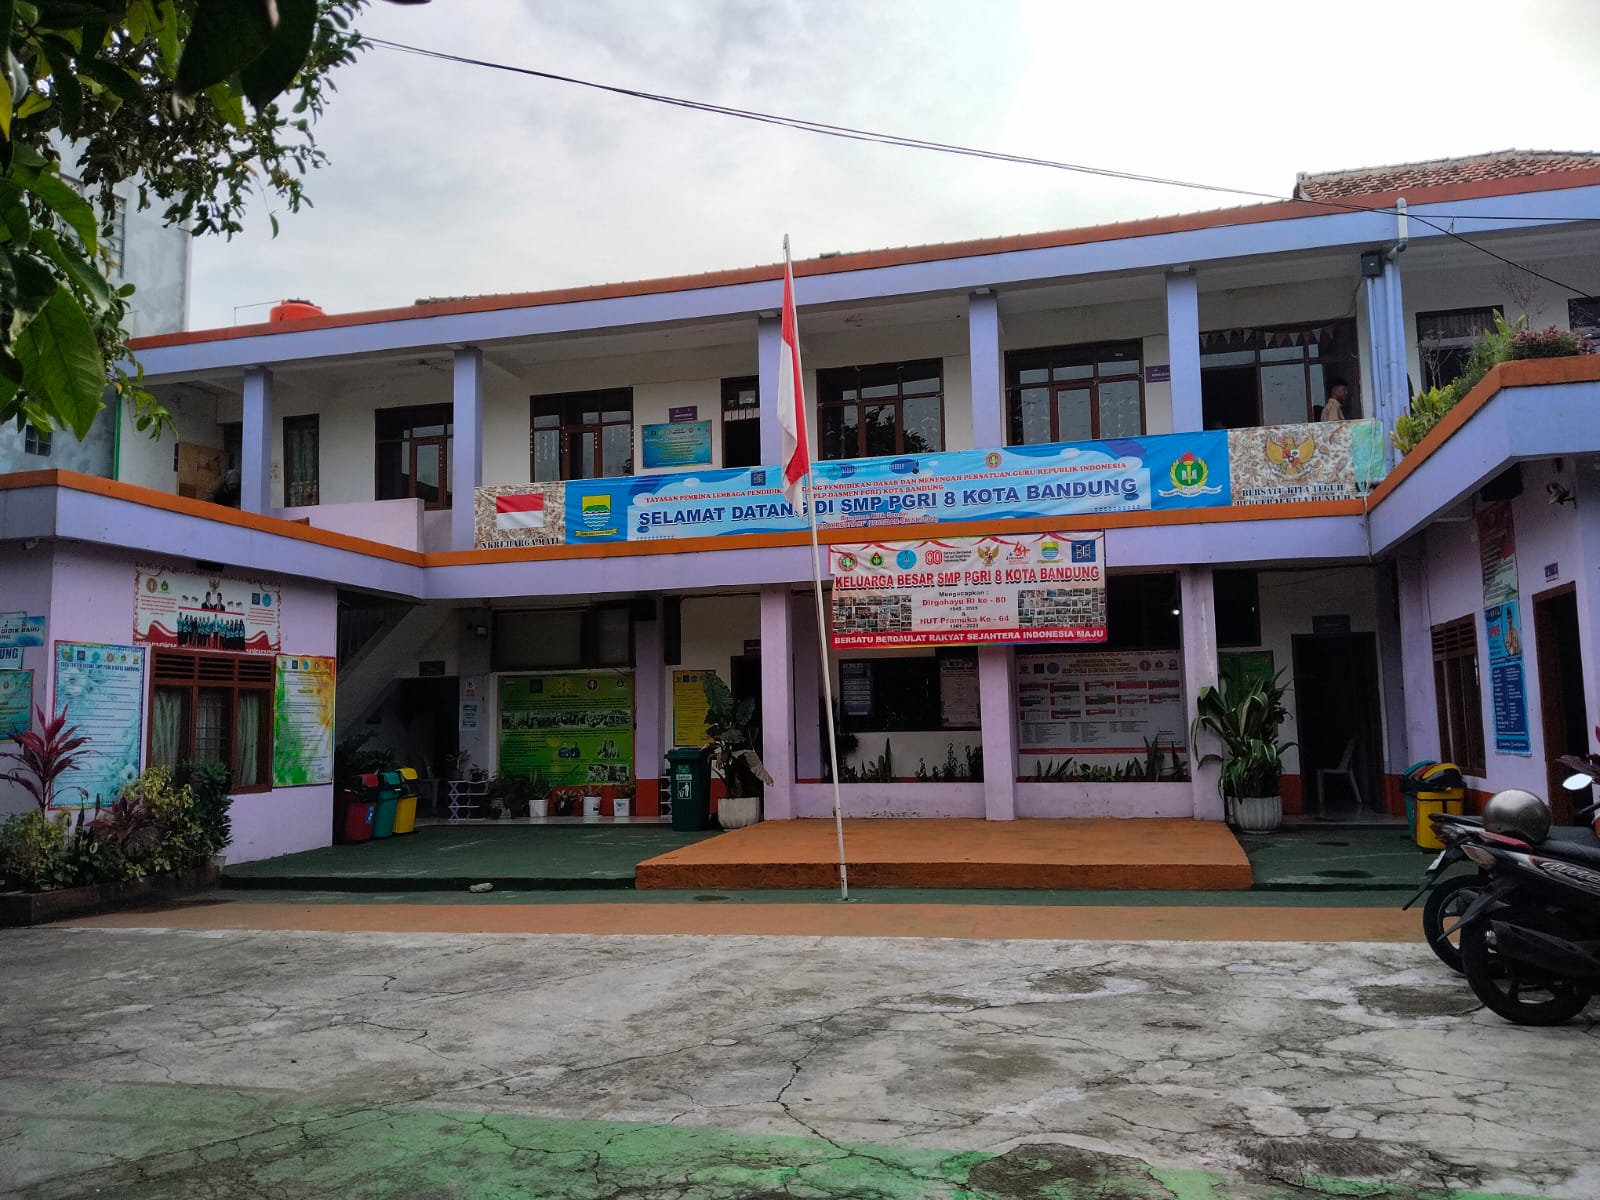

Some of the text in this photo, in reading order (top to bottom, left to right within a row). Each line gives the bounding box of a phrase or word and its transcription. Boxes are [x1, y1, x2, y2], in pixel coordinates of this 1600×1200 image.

[646, 494, 678, 503] YAYASAN
[680, 492, 711, 501] PEMBINA
[713, 490, 744, 499] LEMBAGA
[824, 481, 872, 491] PENDIDIKAN
[901, 478, 916, 486] DAN
[918, 474, 962, 484] MENENGAH
[964, 472, 1010, 480] PERSATUAN
[1013, 469, 1034, 478] GURU
[1038, 466, 1078, 476] REPUBLIK
[1080, 463, 1126, 472] INDONESIA
[906, 484, 944, 493] BANDUNG
[1242, 487, 1284, 497] BERSATU
[1286, 486, 1310, 496] KITA
[1313, 484, 1345, 494] TEGUH
[639, 507, 725, 526] SELAMAT
[815, 500, 834, 514] DI
[840, 496, 883, 513] SMP
[889, 492, 937, 510] PGRI
[944, 491, 956, 506] 8
[962, 486, 1021, 505] KOTA
[1026, 478, 1138, 501] BANDUNG
[926, 550, 942, 565] 80
[835, 566, 1100, 588] KELUARGA BESAR SMP PGRI 8 KOTA BANDUNG
[922, 598, 964, 606] Dirgahayu
[940, 616, 978, 624] Pramuka
[834, 629, 1104, 644] BERSATU BERDAULAT RAKYAT SEJAHTERA INDONESIA MAJU
